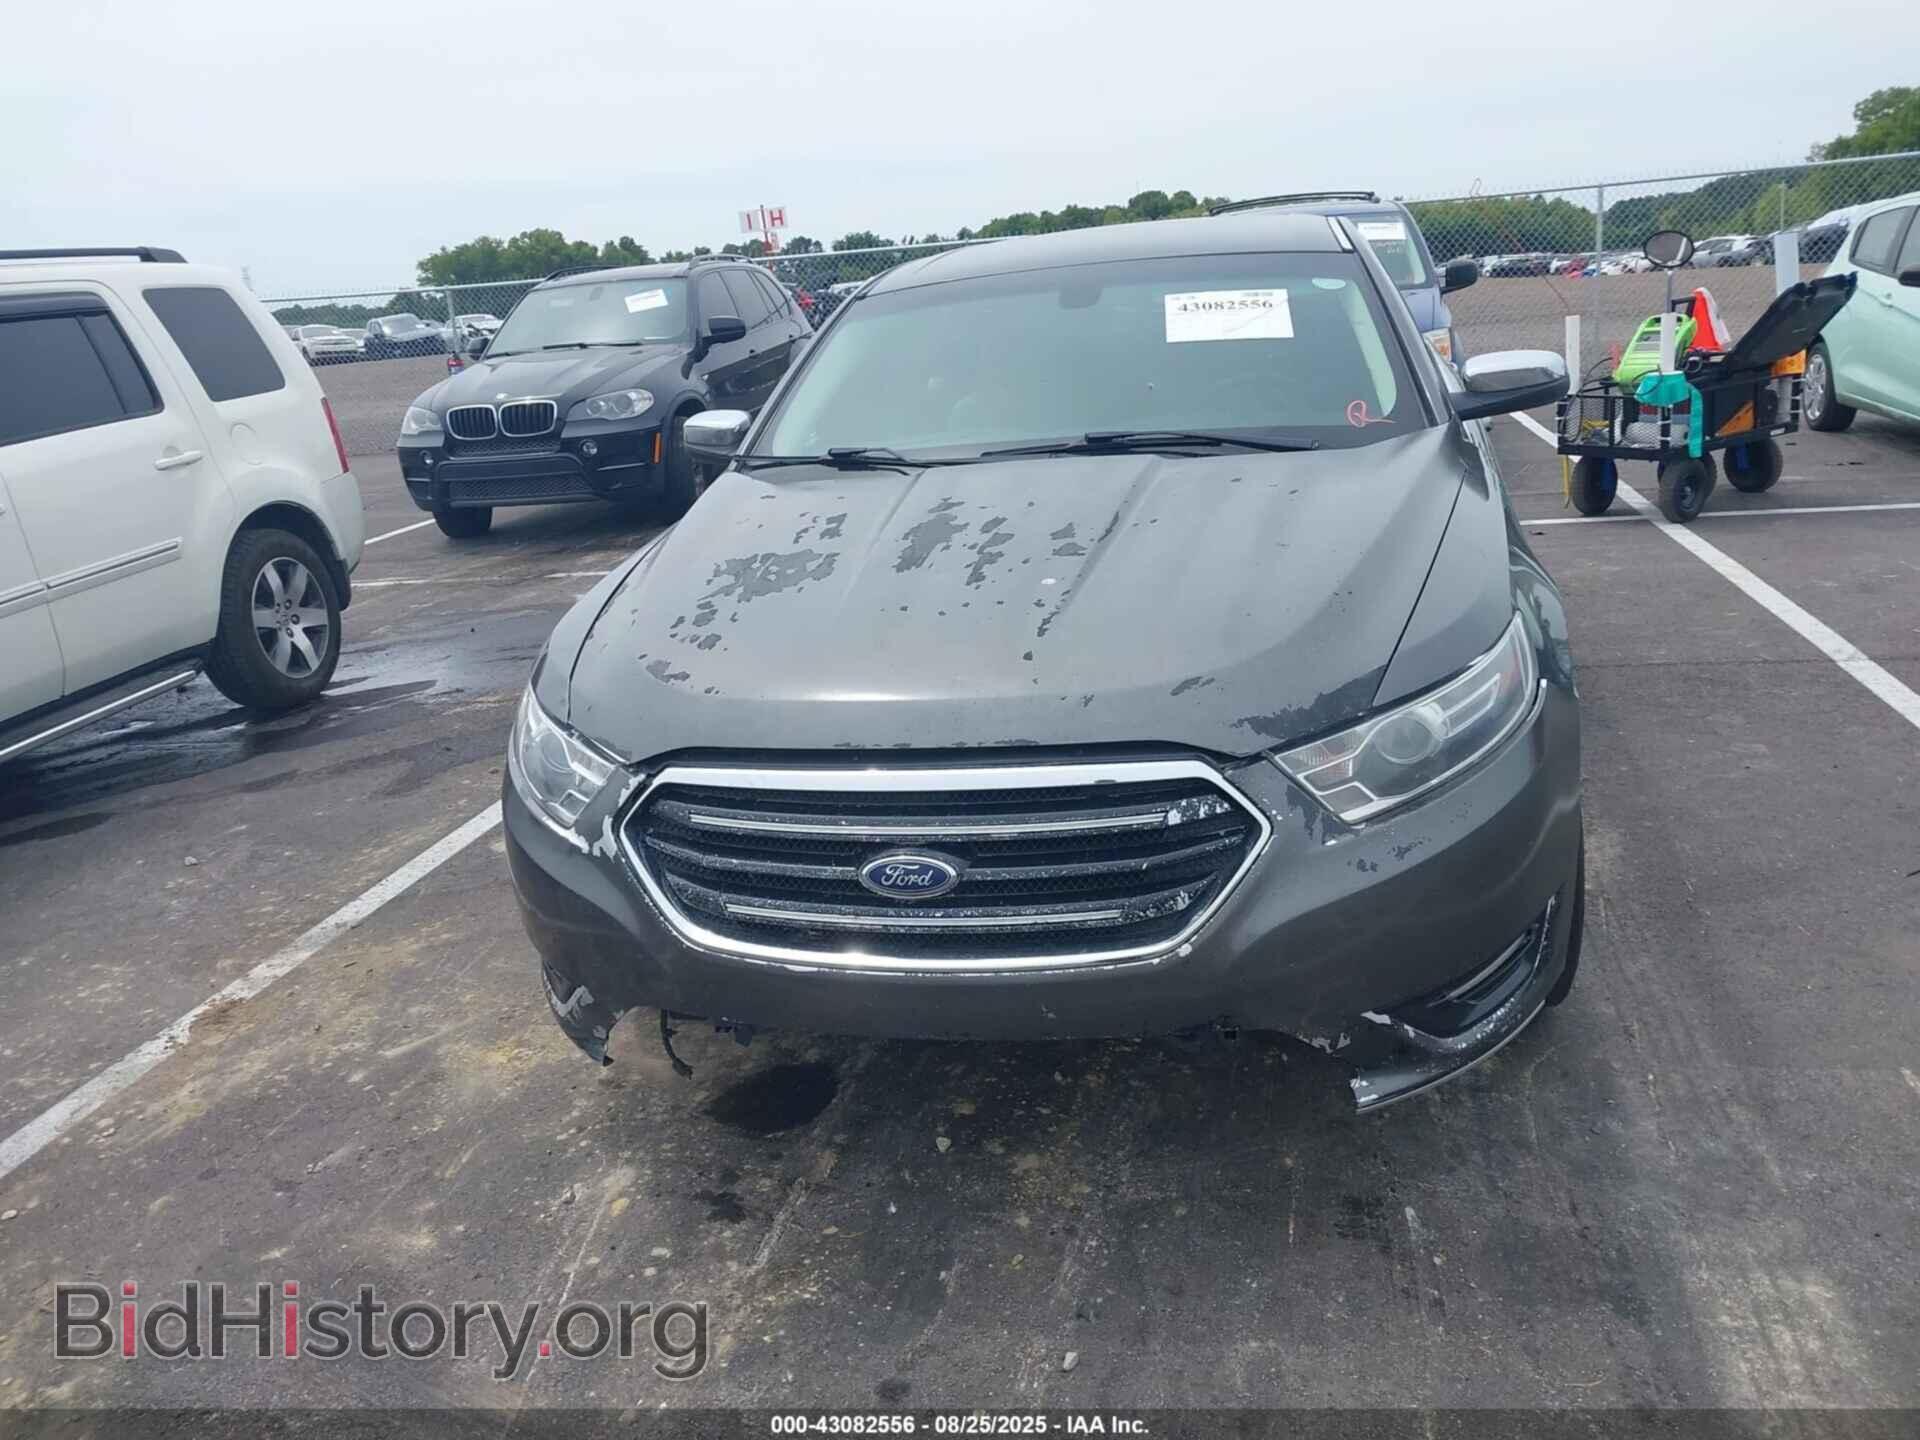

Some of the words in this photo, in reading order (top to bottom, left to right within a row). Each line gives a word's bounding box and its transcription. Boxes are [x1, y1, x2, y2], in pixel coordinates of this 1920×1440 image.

[769, 208, 784, 227] H
[1177, 299, 1274, 312] 43082556
[880, 864, 934, 887] Ford
